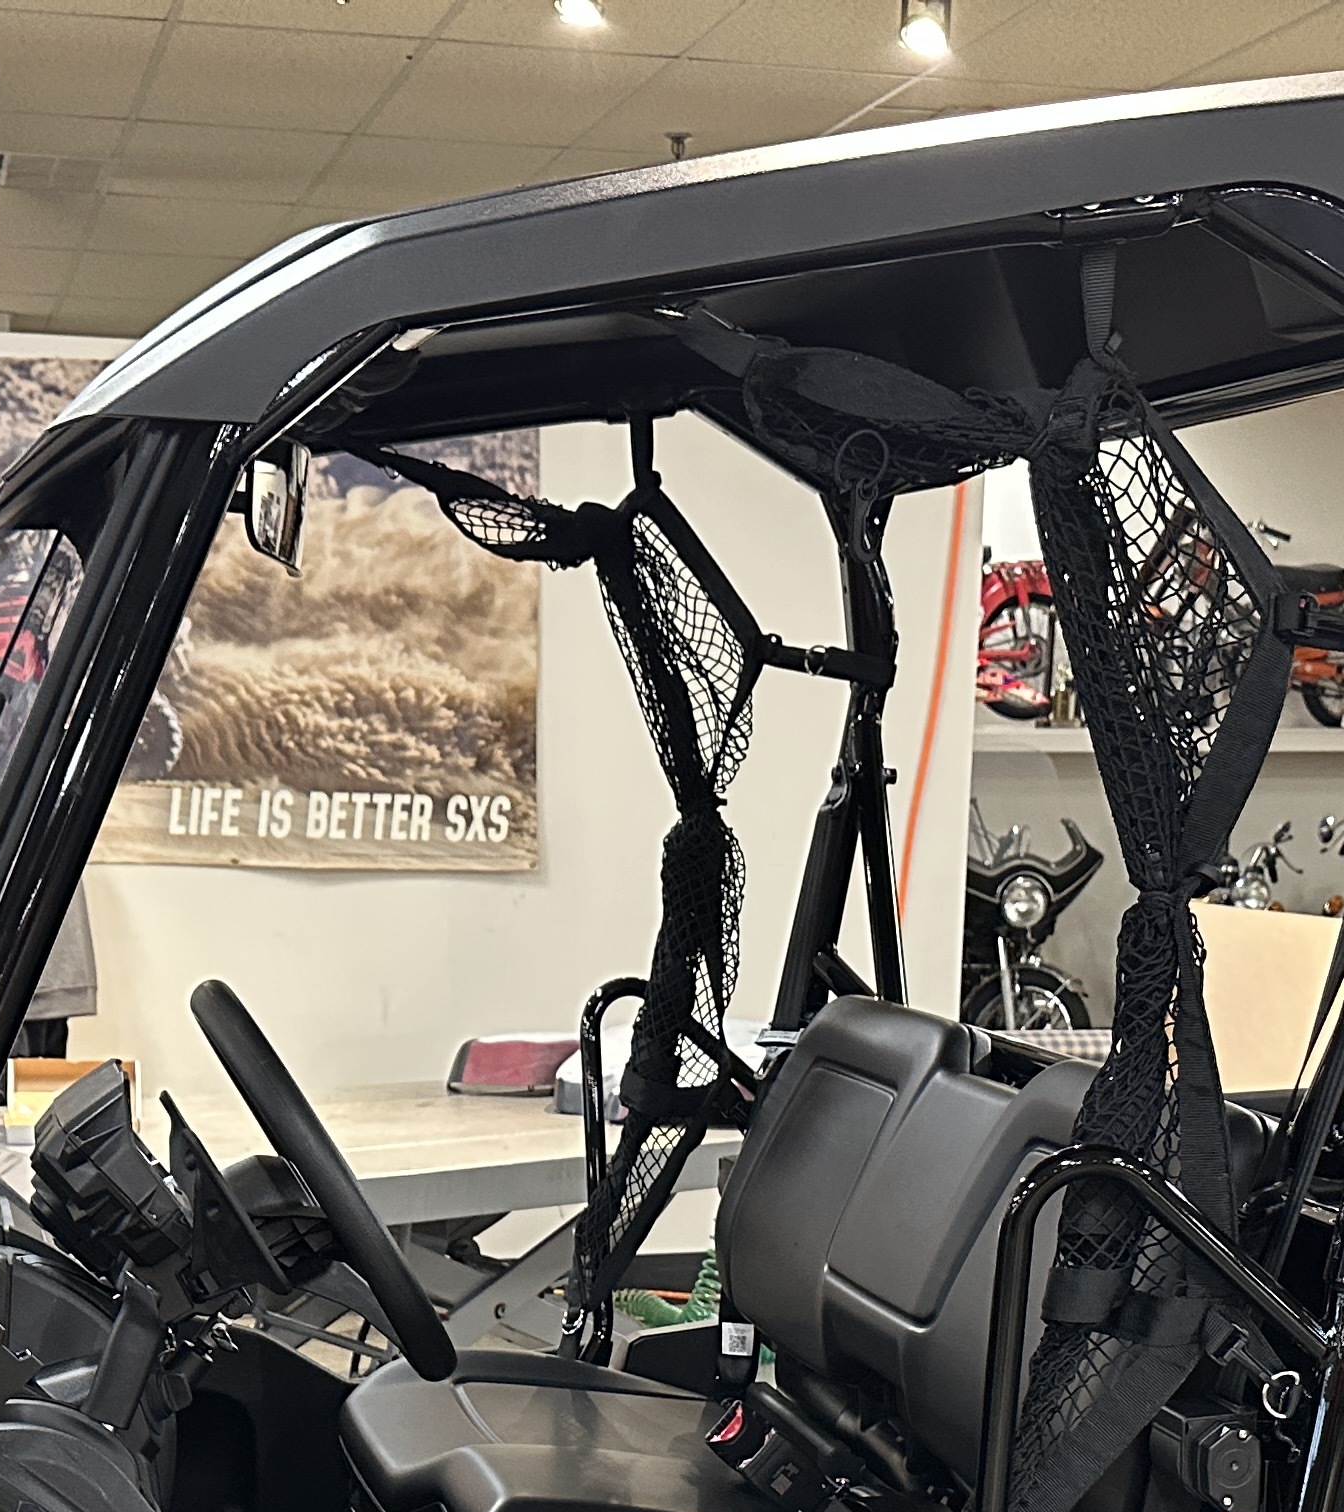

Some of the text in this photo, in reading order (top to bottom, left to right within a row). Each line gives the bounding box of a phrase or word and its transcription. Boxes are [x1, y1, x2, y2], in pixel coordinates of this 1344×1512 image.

[169, 787, 512, 842] LIFE IS BETTER SXS
